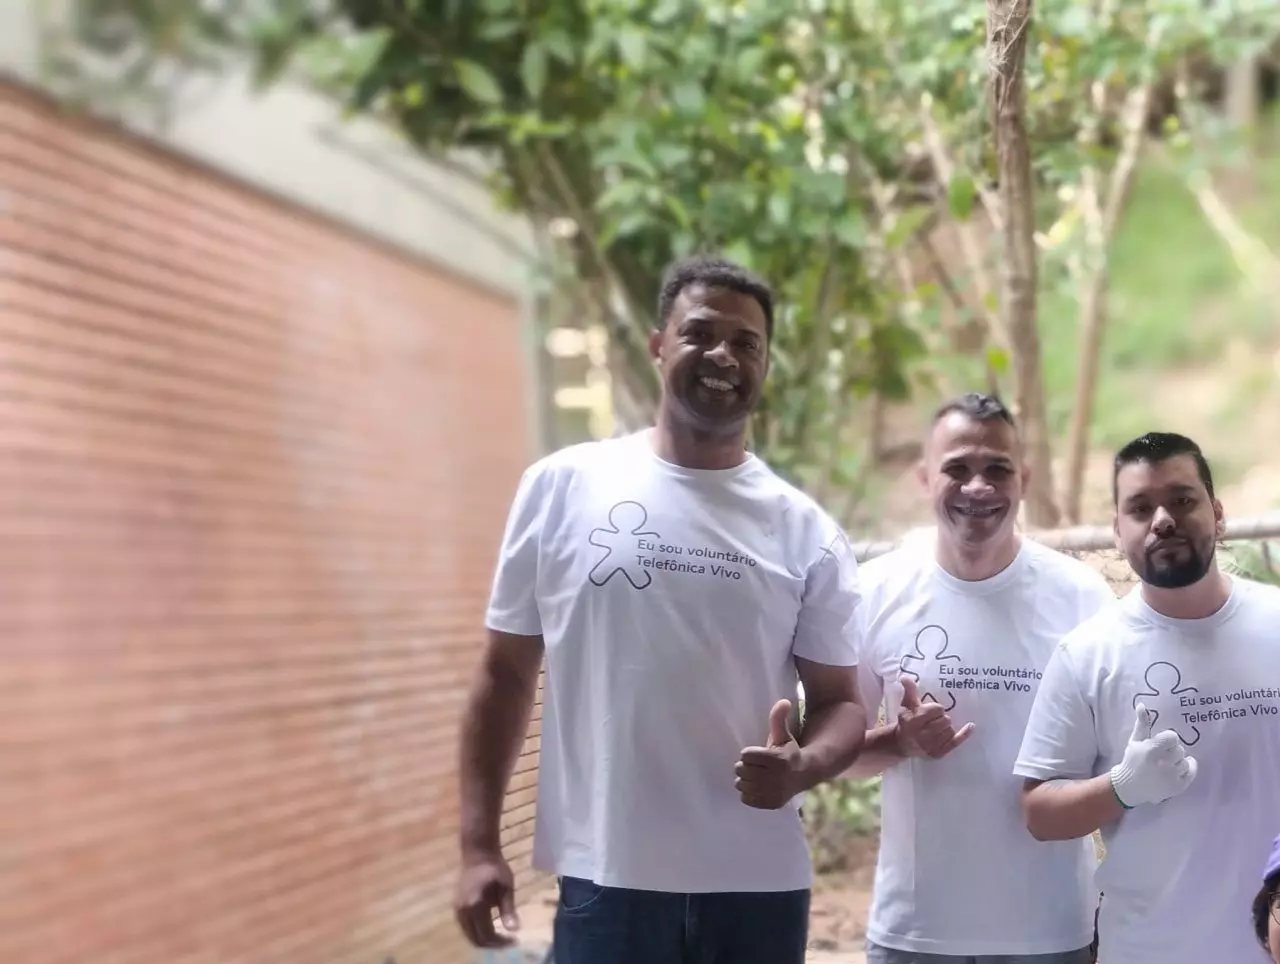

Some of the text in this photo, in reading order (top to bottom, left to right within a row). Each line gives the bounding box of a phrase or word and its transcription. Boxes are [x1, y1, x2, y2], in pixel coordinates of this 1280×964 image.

[637, 539, 757, 567] Eu sou voluntário
[636, 555, 741, 580] Telefônica Vivo
[940, 664, 1043, 680] Eu sou voluntário
[938, 678, 1031, 692] Telefônica Vivo
[1180, 696, 1195, 707] Eu
[1200, 695, 1222, 706] sou
[1181, 704, 1278, 724] Telefônica Vivo
